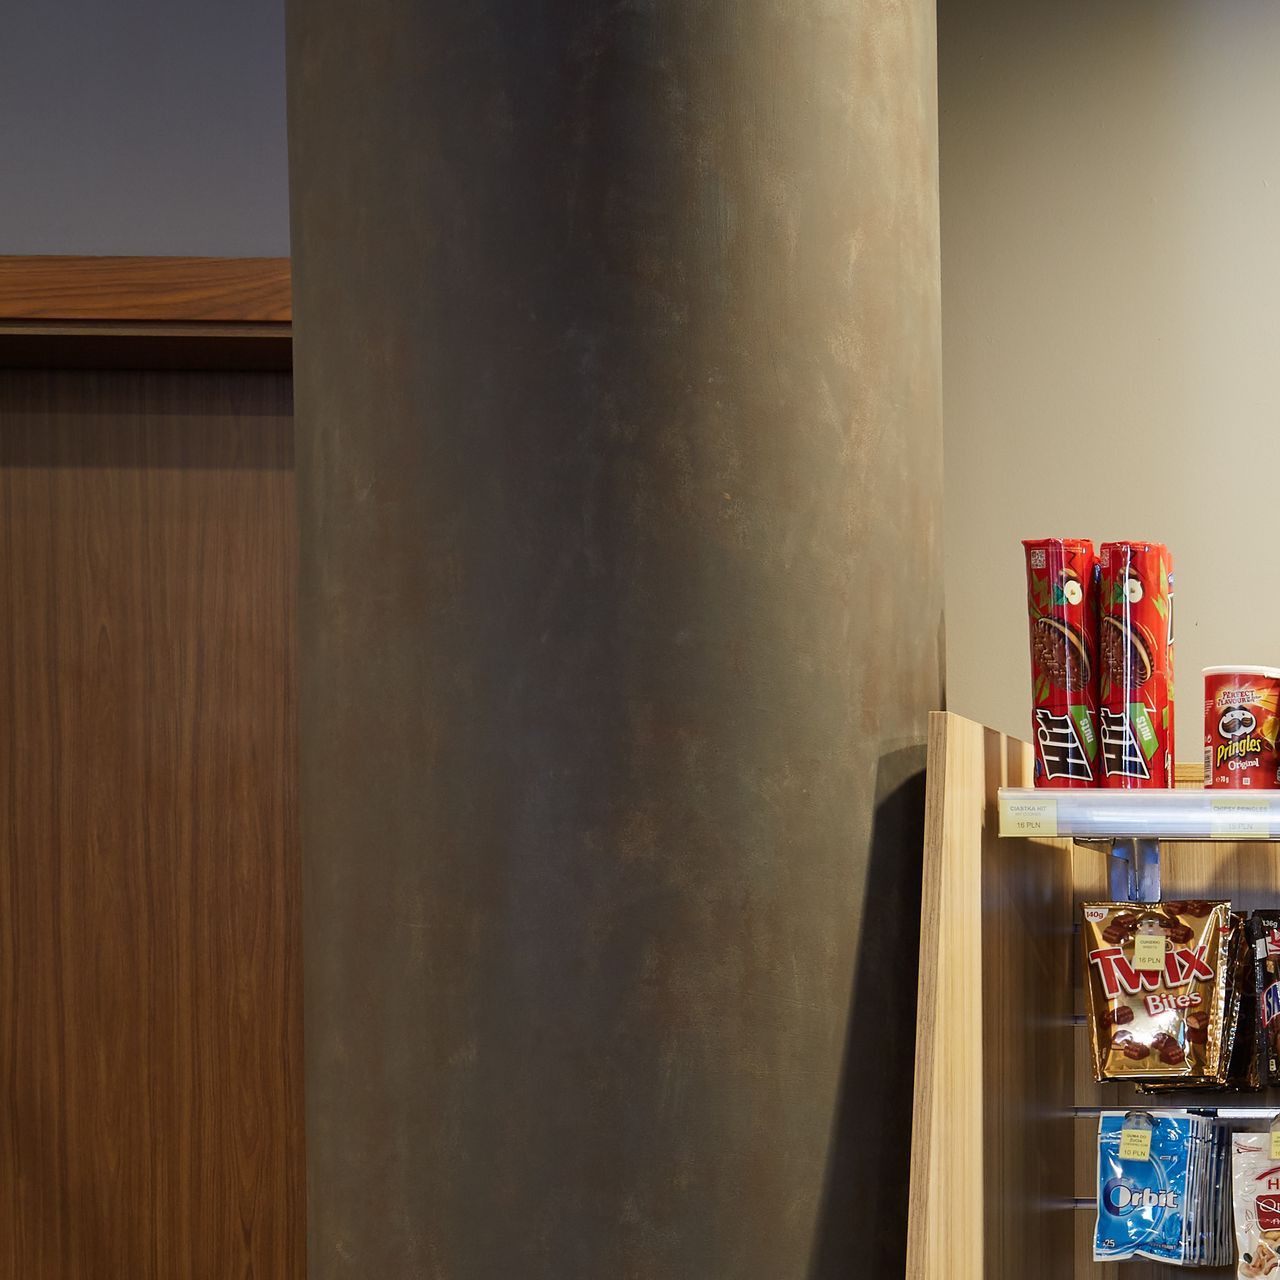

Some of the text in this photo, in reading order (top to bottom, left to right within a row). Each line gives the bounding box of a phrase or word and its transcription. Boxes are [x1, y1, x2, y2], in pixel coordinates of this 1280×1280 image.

[1080, 719, 1093, 743] nuts
[1138, 716, 1151, 741] nuts
[1035, 708, 1093, 781] Hit
[1101, 707, 1150, 780] Hit
[1216, 737, 1262, 767] Pringles
[1228, 758, 1260, 771] Original
[1147, 992, 1201, 1015] Bites
[1105, 1180, 1178, 1214] Orbit
